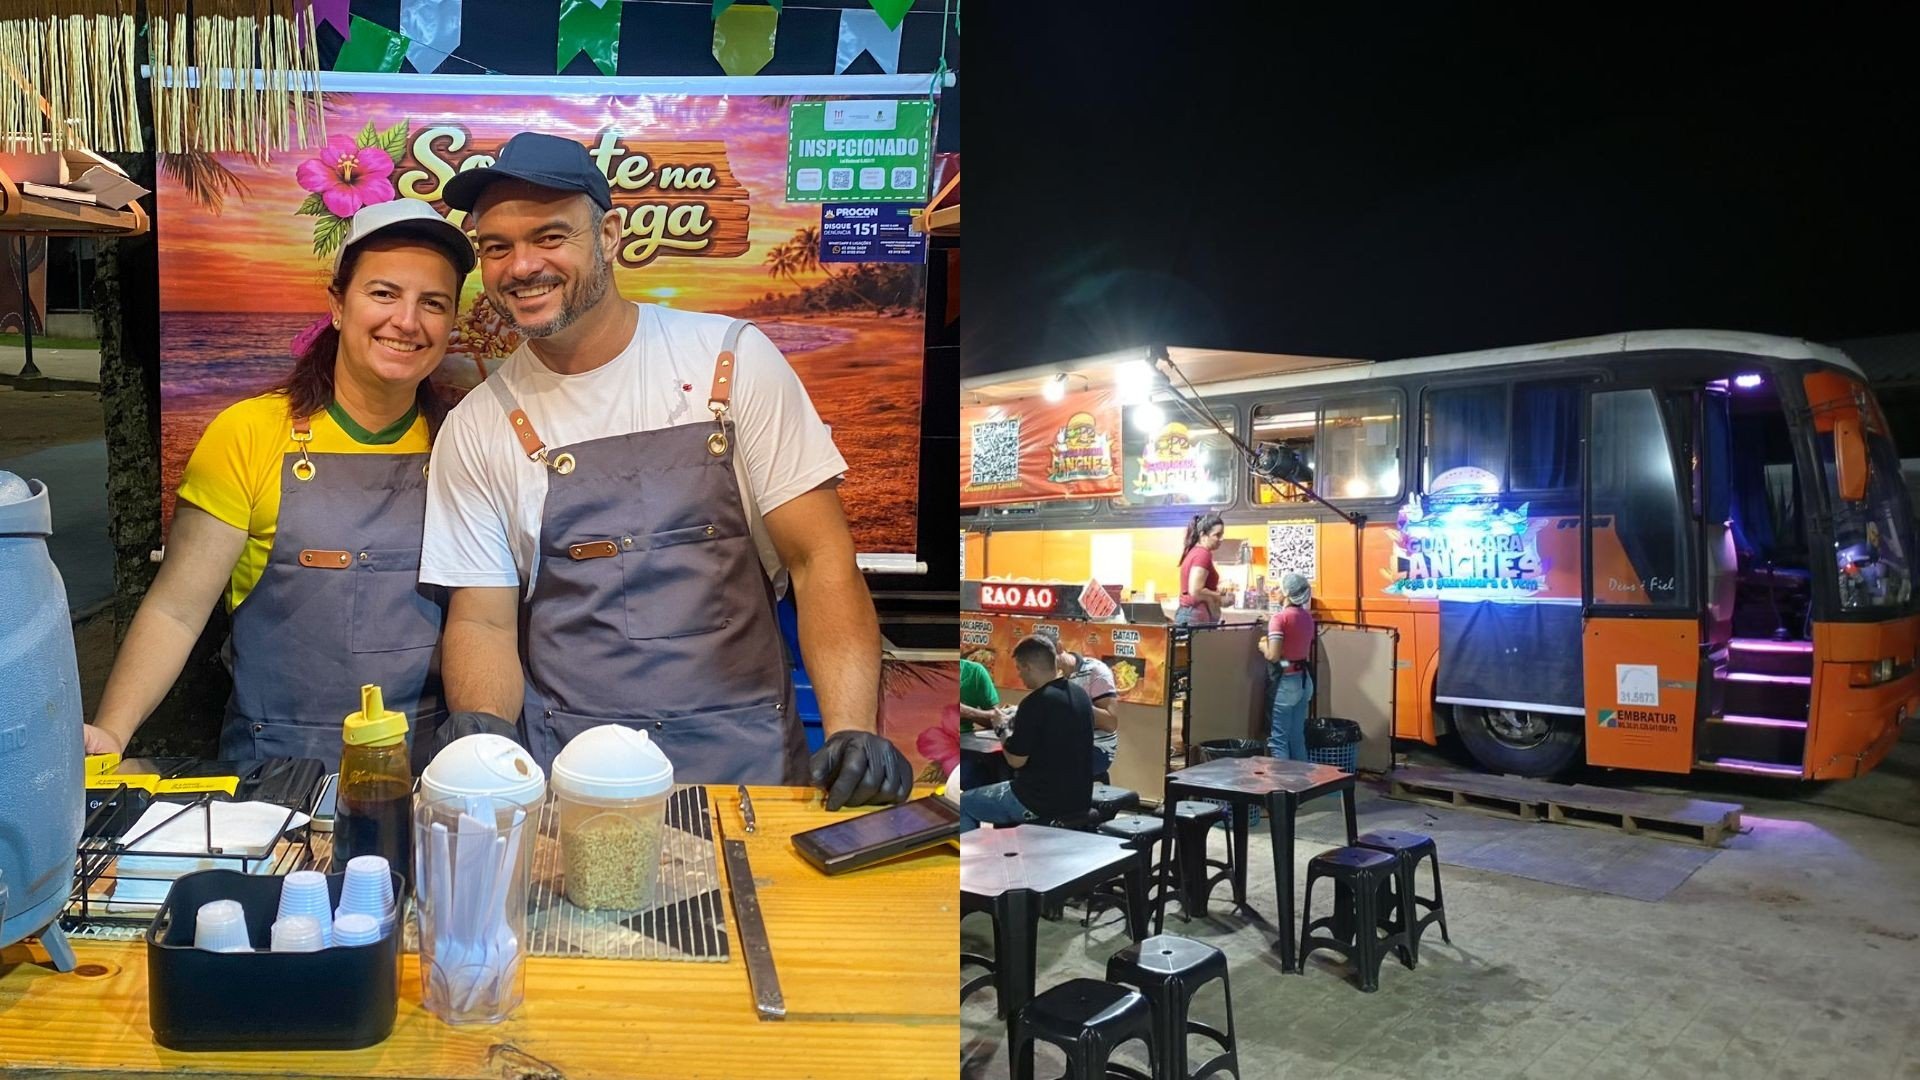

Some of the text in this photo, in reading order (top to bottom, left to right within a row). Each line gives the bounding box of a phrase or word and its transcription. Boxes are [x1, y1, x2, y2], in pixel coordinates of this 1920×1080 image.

[799, 138, 919, 157] INSPECIONADO
[659, 166, 716, 189] na
[836, 207, 878, 216] PROCON
[853, 223, 878, 236] 151
[1407, 533, 1524, 553] GUAARA
[1510, 578, 1538, 591] vem
[1608, 577, 1636, 592] Deus
[1650, 576, 1675, 592] Fiel
[1022, 587, 1052, 608] AO
[1112, 629, 1139, 642] BATATA
[1114, 643, 1135, 657] FRITA
[1617, 710, 1676, 724] EMBRATUR
